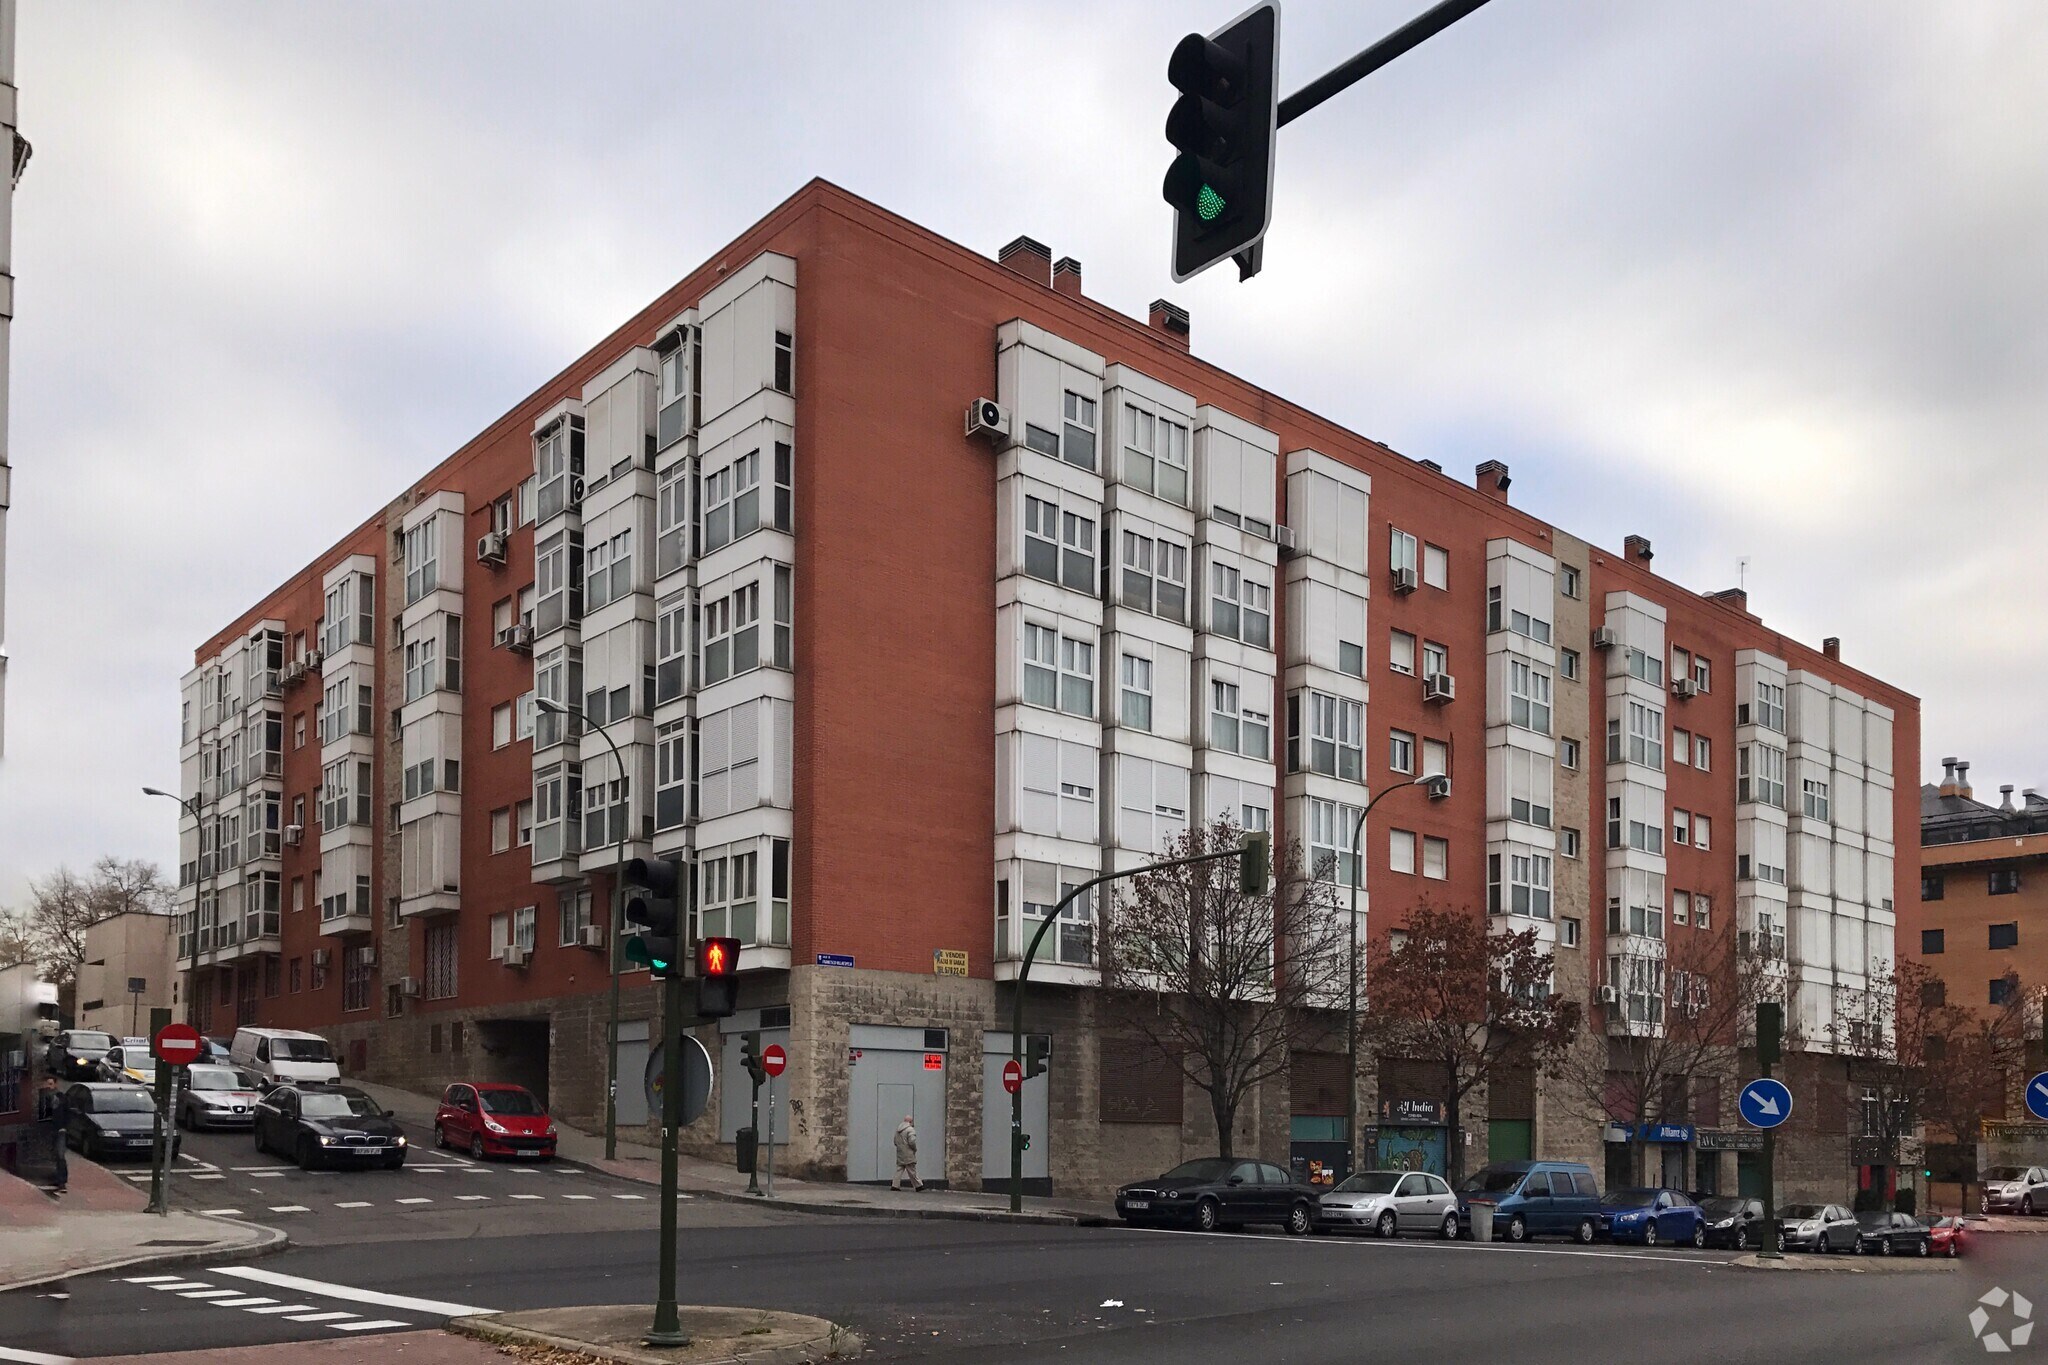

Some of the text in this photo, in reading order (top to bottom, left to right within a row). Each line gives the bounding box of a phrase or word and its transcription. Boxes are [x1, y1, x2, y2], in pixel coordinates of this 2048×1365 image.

[1412, 1100, 1433, 1112] India
[1660, 1126, 1681, 1138] Allianz
[1701, 1135, 1716, 1147] AVC
